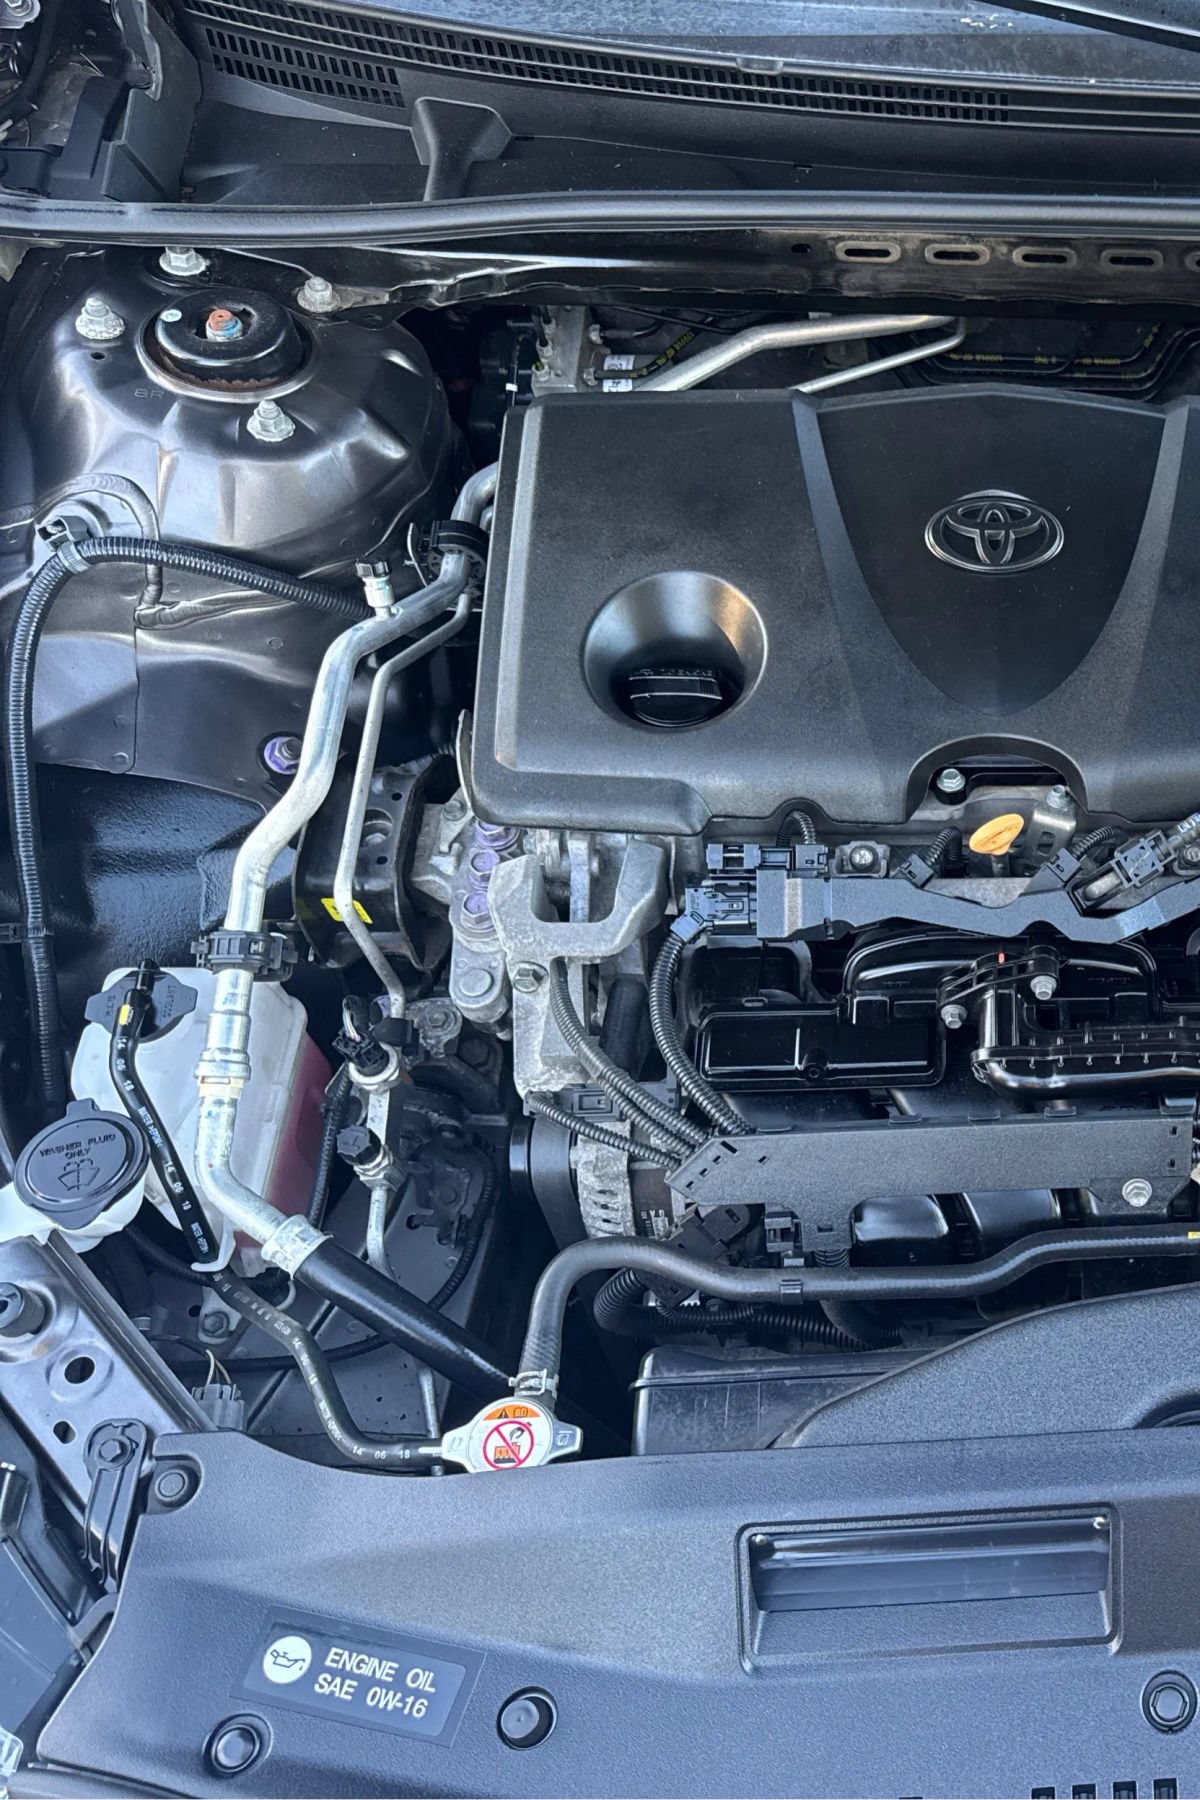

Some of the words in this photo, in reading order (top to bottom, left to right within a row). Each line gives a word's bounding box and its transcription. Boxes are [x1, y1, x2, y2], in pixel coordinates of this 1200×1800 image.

[40, 1140, 82, 1157] WASHER
[87, 1132, 116, 1147] FLUID
[65, 1147, 91, 1160] ONLY
[399, 1450, 410, 1459] 18
[324, 1646, 399, 1682] ENGINE
[405, 1667, 436, 1693] OIL
[313, 1672, 359, 1700] SAE
[366, 1686, 429, 1719] 0W-16
